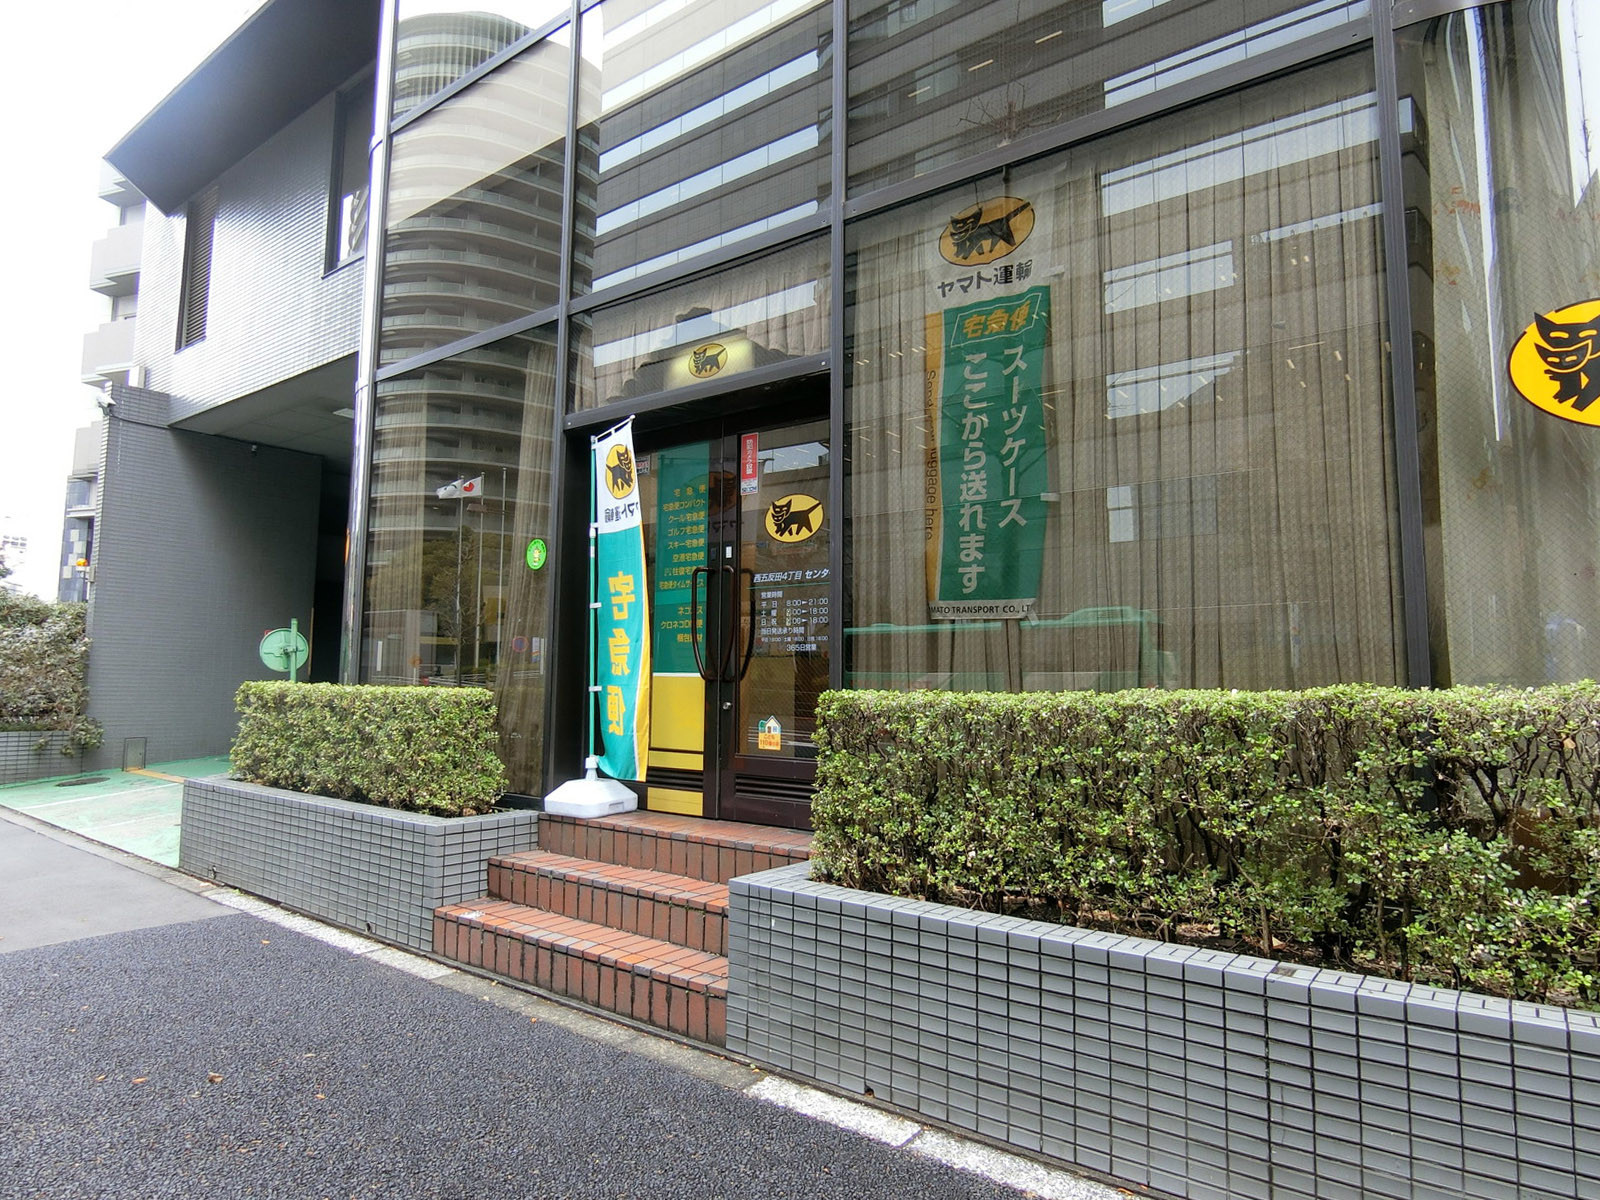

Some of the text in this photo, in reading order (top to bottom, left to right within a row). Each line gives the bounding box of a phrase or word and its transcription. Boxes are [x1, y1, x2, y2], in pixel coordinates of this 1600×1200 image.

[937, 259, 1033, 298] ヤマト運輸
[963, 300, 1031, 338] 宅急便
[998, 344, 1029, 527] スーツケース
[958, 352, 988, 594] ここから送れます
[663, 499, 706, 511] 宅急便コンパクト
[668, 511, 706, 523] クール宅急便
[667, 524, 705, 536] ゴルフ宅急便
[667, 538, 705, 549] スキー宅急便
[672, 551, 705, 562] 空港宅急便
[805, 568, 831, 578] センタ
[761, 591, 783, 599] 営業時間
[677, 605, 703, 616] ネコス
[952, 605, 999, 614] TRANSPORT
[1002, 603, 1020, 614] CO.,
